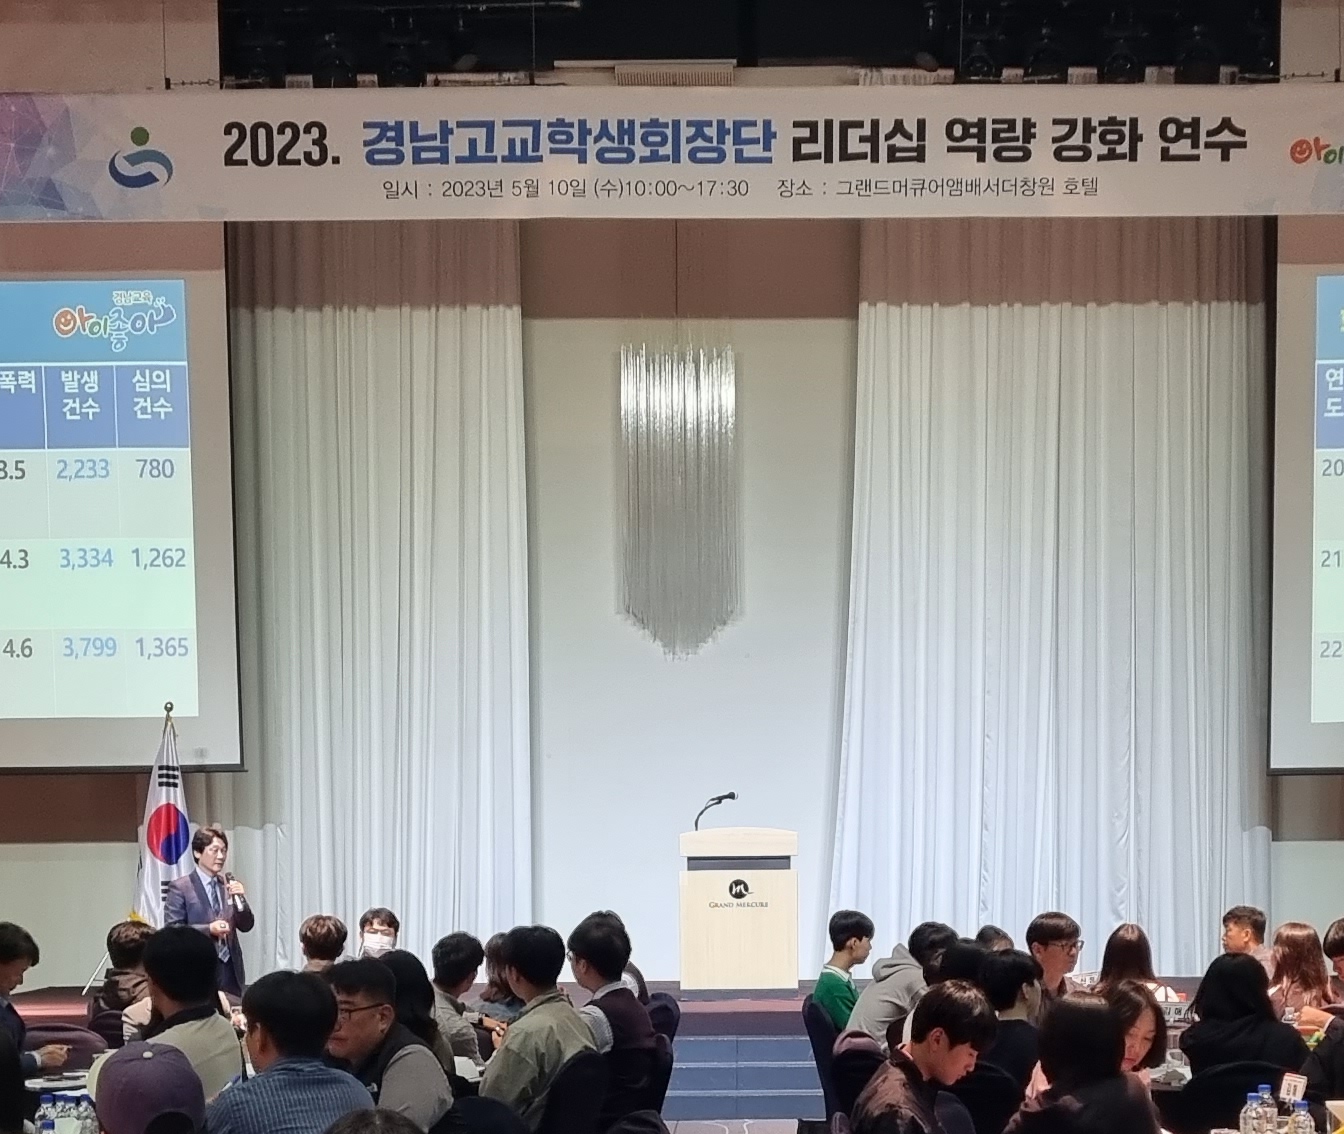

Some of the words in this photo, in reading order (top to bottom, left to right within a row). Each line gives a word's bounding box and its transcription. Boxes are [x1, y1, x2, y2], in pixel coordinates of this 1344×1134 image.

[224, 121, 340, 167] 2023.
[363, 118, 777, 166] 경남고교학생회장단
[793, 118, 926, 163] 리더십
[946, 118, 1036, 163] 역량
[1052, 116, 1143, 162] 강화
[1159, 117, 1247, 162] 연수
[383, 181, 417, 199] 일시
[442, 179, 503, 197] 2023년
[512, 179, 538, 198] 5월
[549, 179, 585, 197] 10일
[778, 179, 812, 198] 장소
[837, 178, 1054, 197] 그랜드머큐어앰배서더창원
[1063, 177, 1097, 196] 호텔
[62, 370, 98, 392] 발생
[132, 369, 170, 392] 심의
[63, 398, 100, 420] 건수
[134, 397, 173, 419] 건수
[57, 459, 109, 481] 2,233
[136, 459, 174, 478] 780
[1322, 459, 1344, 476] 20
[0, 549, 29, 569] 4.3
[60, 548, 113, 570] 3,334
[132, 548, 185, 570] 1,262
[1321, 551, 1340, 567] 21
[3, 638, 32, 658] 4.6
[63, 637, 116, 659] 3,799
[136, 637, 188, 660] 1,365
[1320, 641, 1342, 658] 22
[708, 901, 734, 909] GRAND
[736, 901, 769, 909] MERCURE
